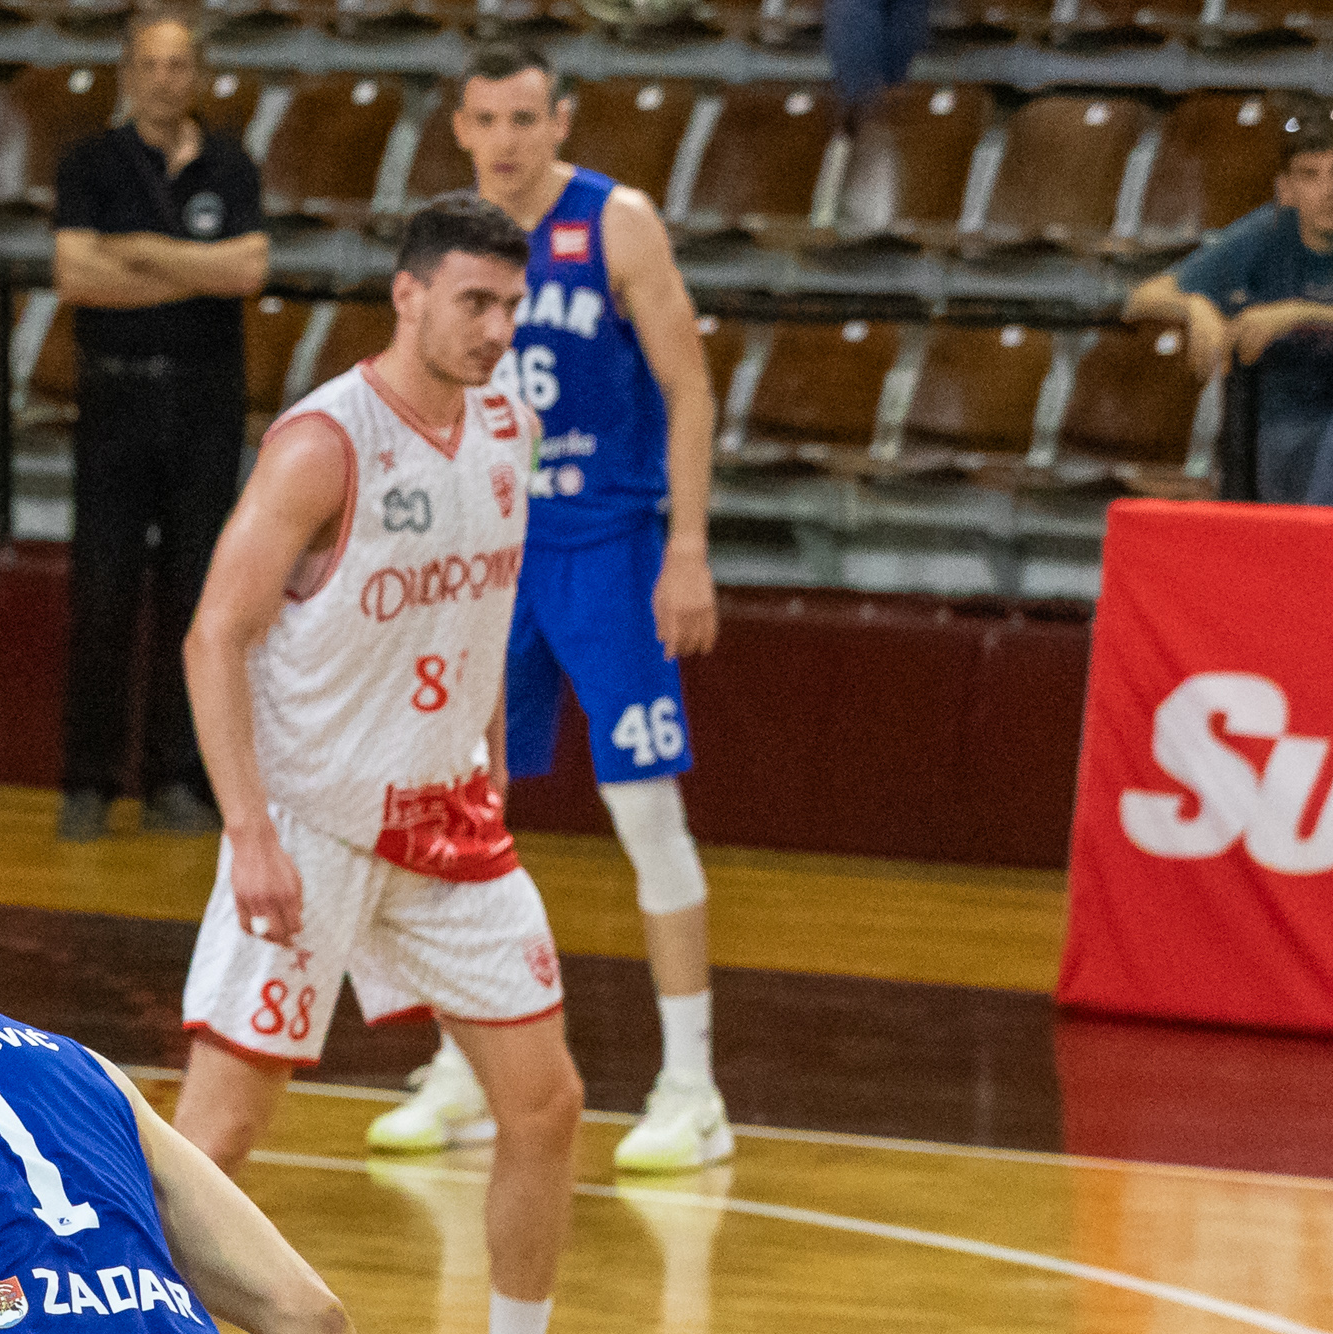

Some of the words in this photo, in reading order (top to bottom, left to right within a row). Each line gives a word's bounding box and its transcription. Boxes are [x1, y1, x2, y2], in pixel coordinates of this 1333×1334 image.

[611, 697, 684, 767] 46
[250, 979, 316, 1042] 88
[31, 1265, 206, 1326] ZADAR
